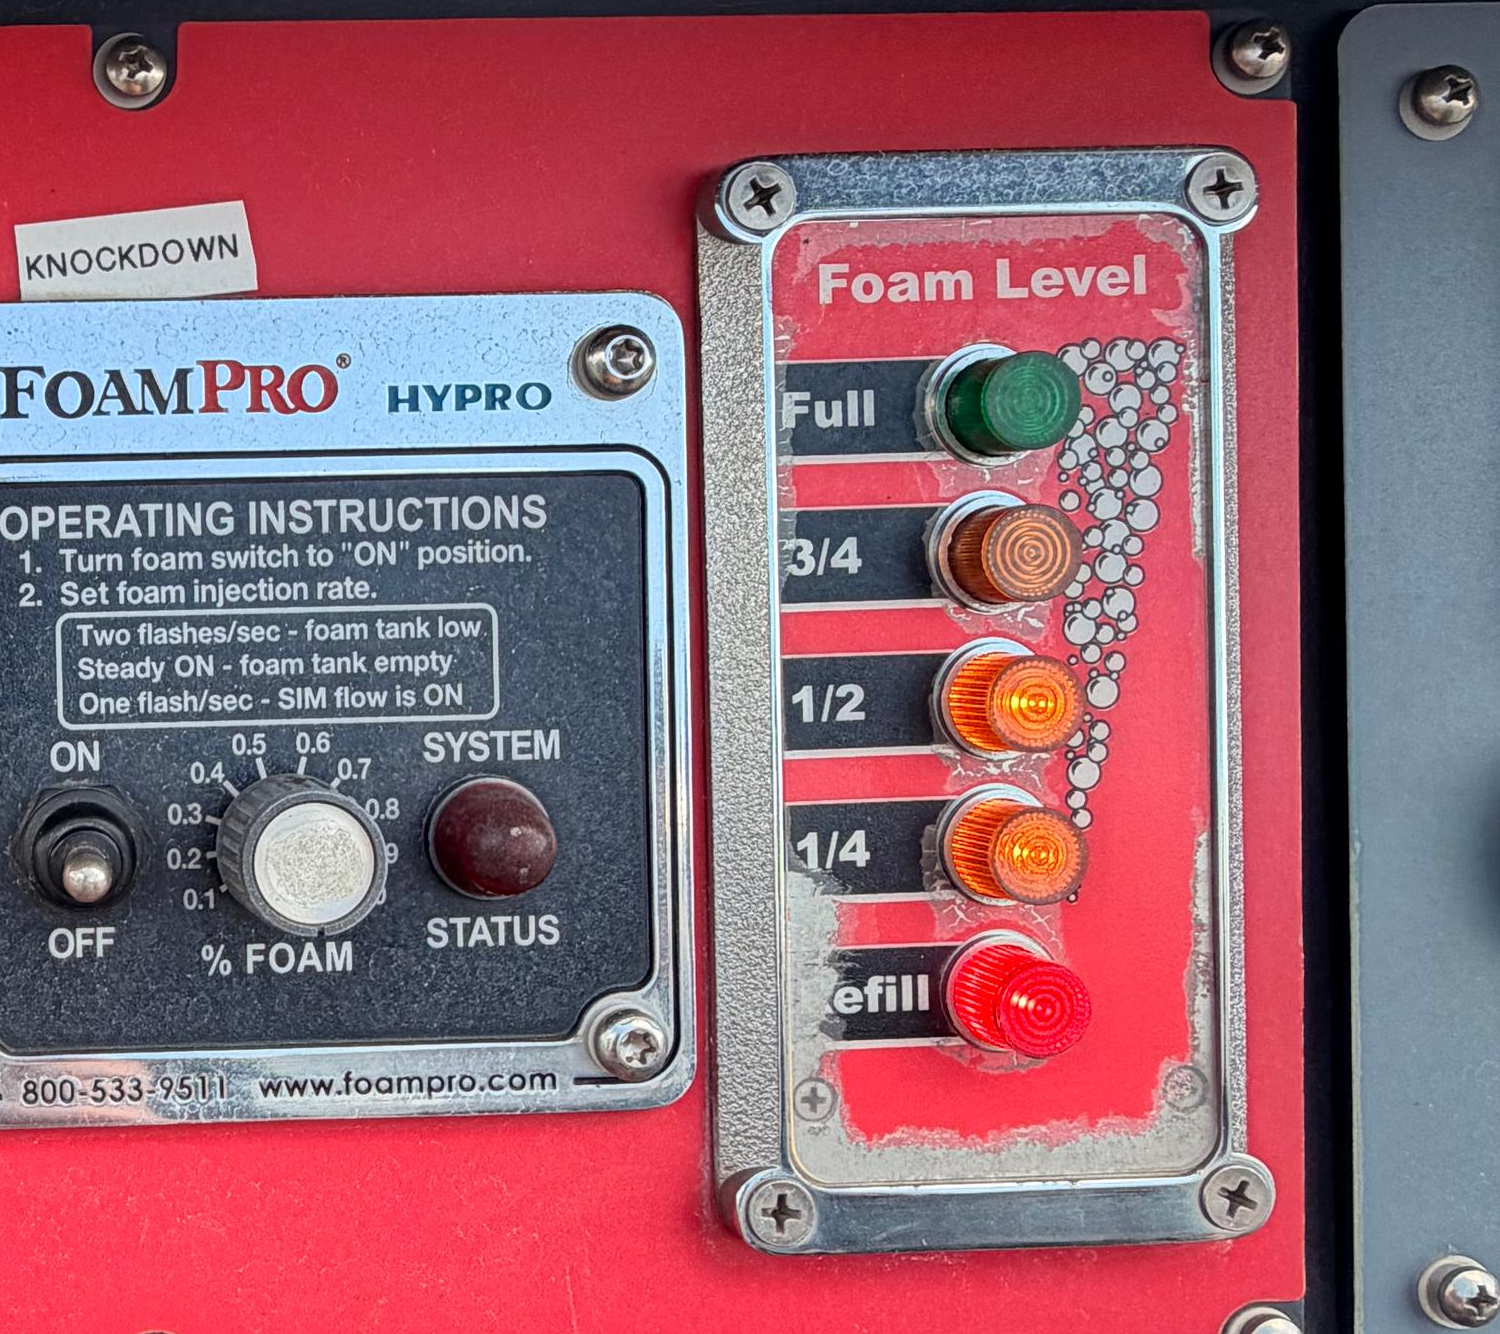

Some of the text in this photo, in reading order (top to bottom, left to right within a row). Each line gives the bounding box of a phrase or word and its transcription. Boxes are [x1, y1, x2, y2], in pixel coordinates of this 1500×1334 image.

[26, 234, 238, 280] KNOCKDOWN
[819, 255, 1146, 307] Foam Level
[388, 383, 551, 413] HYPRO
[782, 391, 875, 427] Full
[0, 495, 546, 540] OPERATING INSTRUCTIONS
[20, 539, 531, 574] 1. Turn foam switch to "ON" position.
[786, 537, 862, 576] 3/4
[19, 576, 376, 606] 2. Set foam injection rate.
[77, 624, 130, 646] Two
[137, 621, 280, 644] flashes/sec
[305, 619, 368, 641] foam
[376, 617, 430, 639] tank
[438, 616, 481, 637] low
[78, 656, 165, 683] Steady
[175, 655, 213, 677] ON
[240, 654, 303, 675] foam
[311, 651, 367, 674] tank
[375, 651, 452, 677] empty
[80, 692, 132, 714] One
[137, 689, 252, 713] flash/sec
[278, 687, 326, 709] SIM
[334, 687, 387, 708] flow
[396, 685, 416, 707] is
[424, 683, 462, 706] ON
[792, 684, 865, 722] 1/2
[51, 741, 99, 772] ON
[232, 733, 266, 755] 0.5
[296, 732, 330, 754] 0.6
[423, 729, 560, 763] SYSTEM
[190, 762, 225, 784] 0.4
[338, 758, 371, 780] 0.7
[168, 803, 202, 825] 0.3
[368, 799, 399, 819] 0.8
[167, 848, 201, 870] 0.2
[797, 830, 870, 869] 1/4
[183, 889, 214, 910] 0.1
[49, 927, 115, 959] OFF
[427, 915, 559, 948] STATUS
[202, 941, 352, 976] % FOAM
[825, 974, 930, 1014] efill
[23, 1071, 556, 1106] 800-533-9511 www.foampro.com
